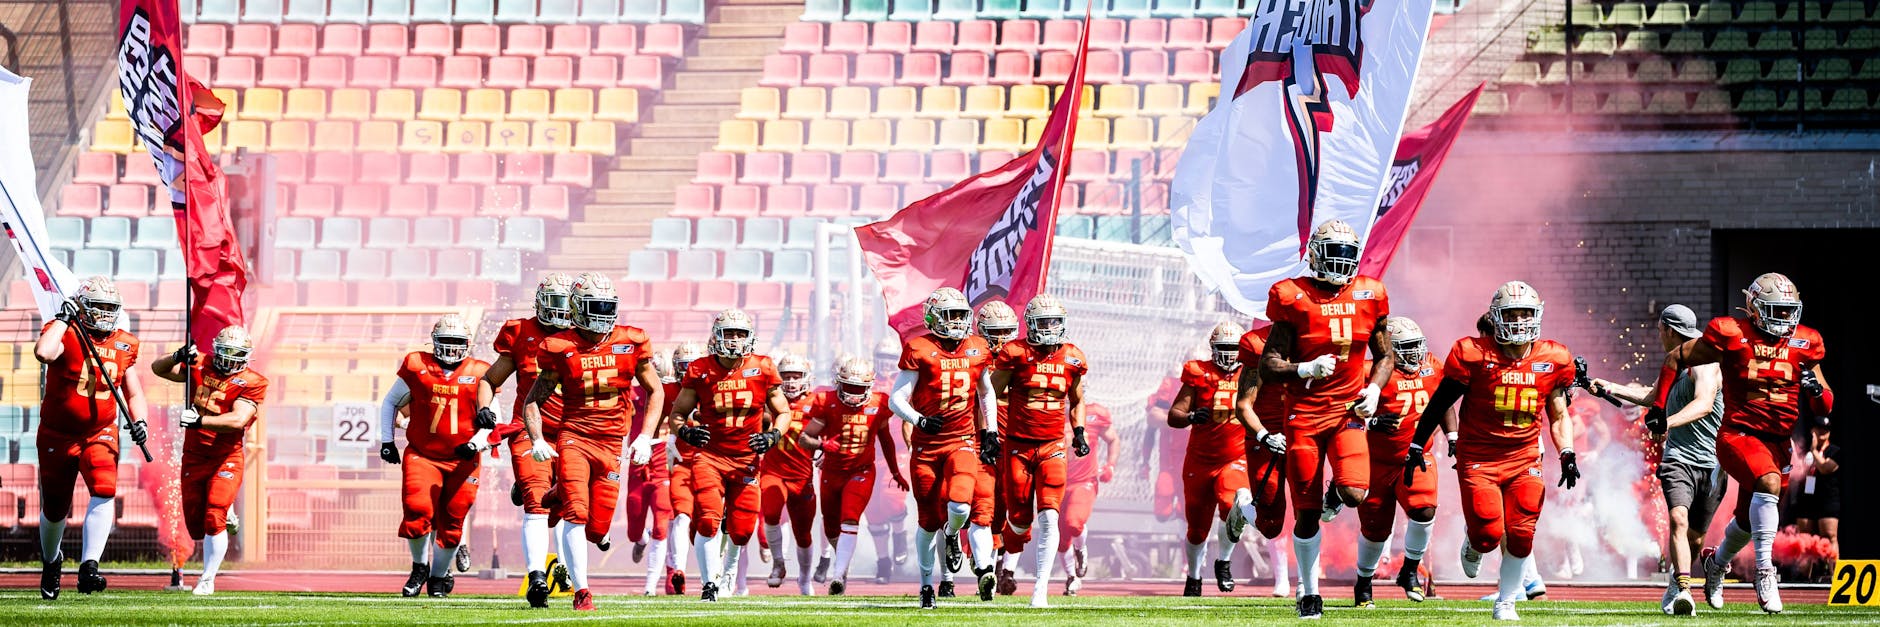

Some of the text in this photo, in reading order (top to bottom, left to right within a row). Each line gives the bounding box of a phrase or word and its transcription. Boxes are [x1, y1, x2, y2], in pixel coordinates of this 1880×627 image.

[1320, 303, 1356, 316] BERLIN
[1328, 317, 1352, 362] 4
[89, 345, 117, 359] ERLIN
[1754, 343, 1789, 360] BERLIN
[580, 355, 616, 370] BERLIN
[940, 358, 970, 370] BERLIN
[1036, 362, 1065, 375] BERLIN
[203, 375, 229, 391] BERLIN
[717, 379, 747, 391] BERLIN
[1218, 381, 1238, 391] BERL
[1397, 379, 1424, 391] BERLIN
[1501, 372, 1536, 385] BERLIN
[433, 383, 459, 395] BERLIN
[582, 368, 618, 408] 15
[940, 371, 971, 411] 13
[1027, 374, 1067, 410] 22
[430, 396, 459, 434] 71
[713, 391, 753, 428] 47
[1494, 386, 1539, 429] 40
[842, 414, 868, 425] BERLIN
[338, 420, 370, 442] 22
[1831, 563, 1877, 604] 20
